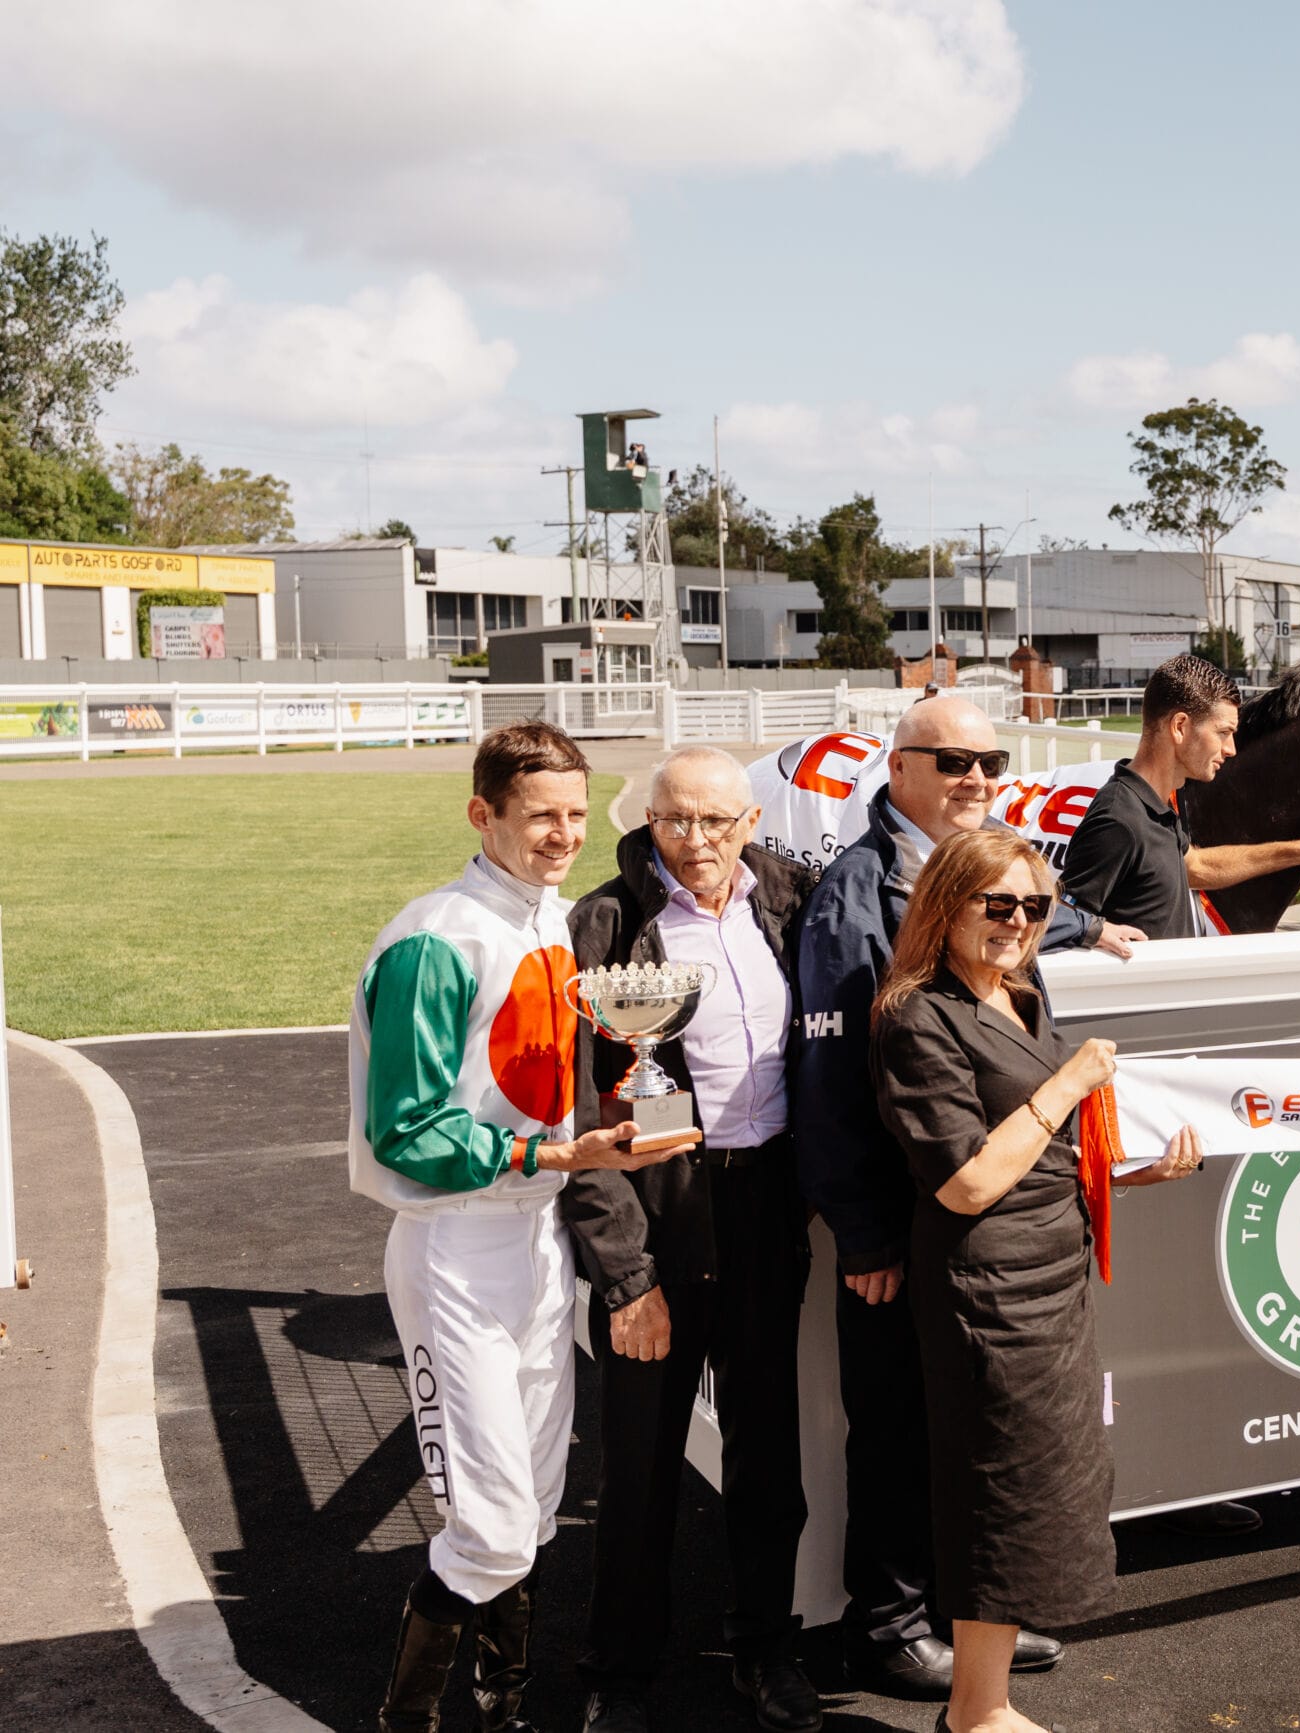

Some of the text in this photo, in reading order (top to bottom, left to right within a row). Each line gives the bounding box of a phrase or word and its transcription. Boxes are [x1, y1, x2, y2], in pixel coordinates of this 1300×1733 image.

[1276, 621, 1289, 636] 16
[287, 703, 327, 716] ORTUS
[804, 1011, 843, 1039] HH
[1241, 1179, 1271, 1244] THE
